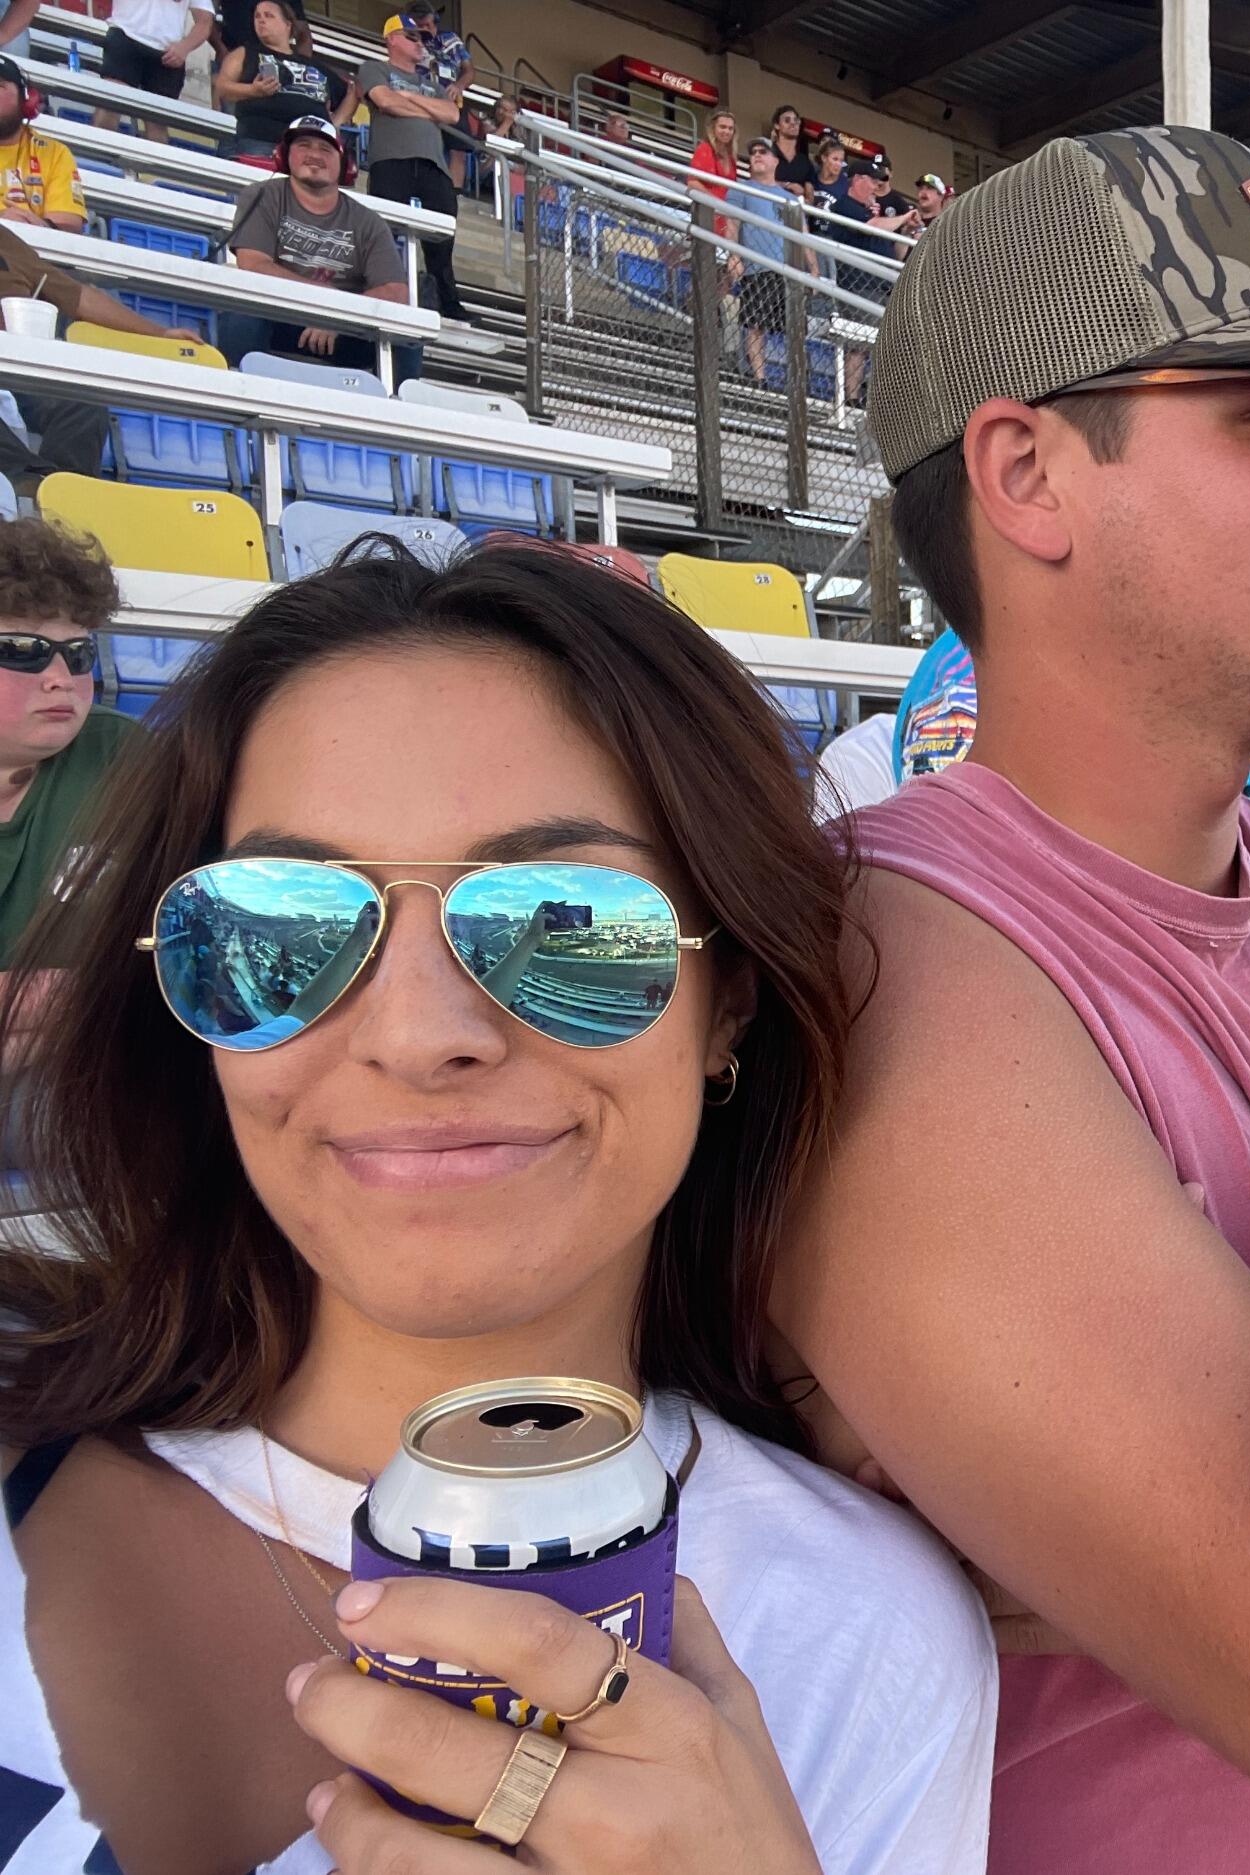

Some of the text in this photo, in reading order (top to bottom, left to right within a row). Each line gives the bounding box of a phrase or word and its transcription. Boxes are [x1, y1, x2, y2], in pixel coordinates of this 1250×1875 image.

[195, 503, 215, 513] 25
[416, 529, 433, 540] 26
[756, 576, 770, 584] 28
